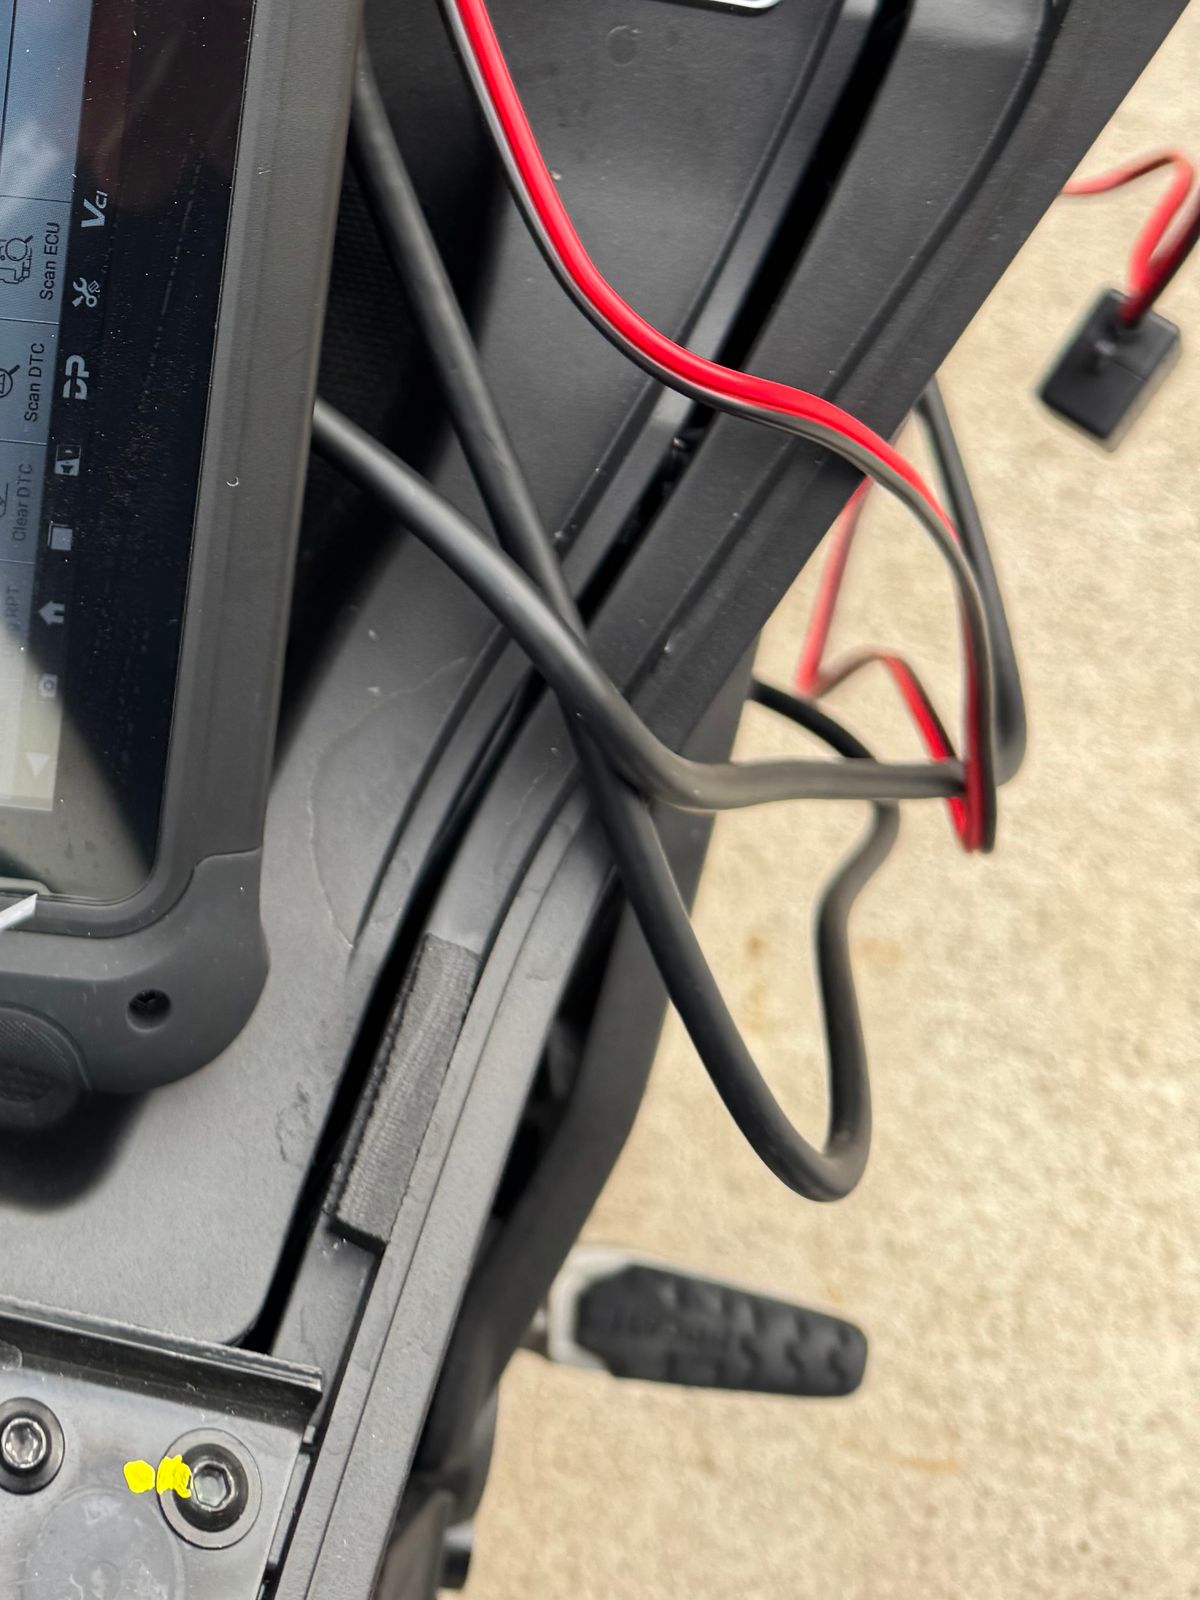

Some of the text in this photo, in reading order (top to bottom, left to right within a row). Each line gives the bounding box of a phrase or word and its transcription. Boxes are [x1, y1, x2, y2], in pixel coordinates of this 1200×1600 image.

[39, 220, 61, 300] Scan ECU
[23, 341, 46, 422] Scan DTC
[62, 353, 90, 400] DP
[11, 461, 34, 541] Clear DTC
[5, 584, 21, 617] RPT
